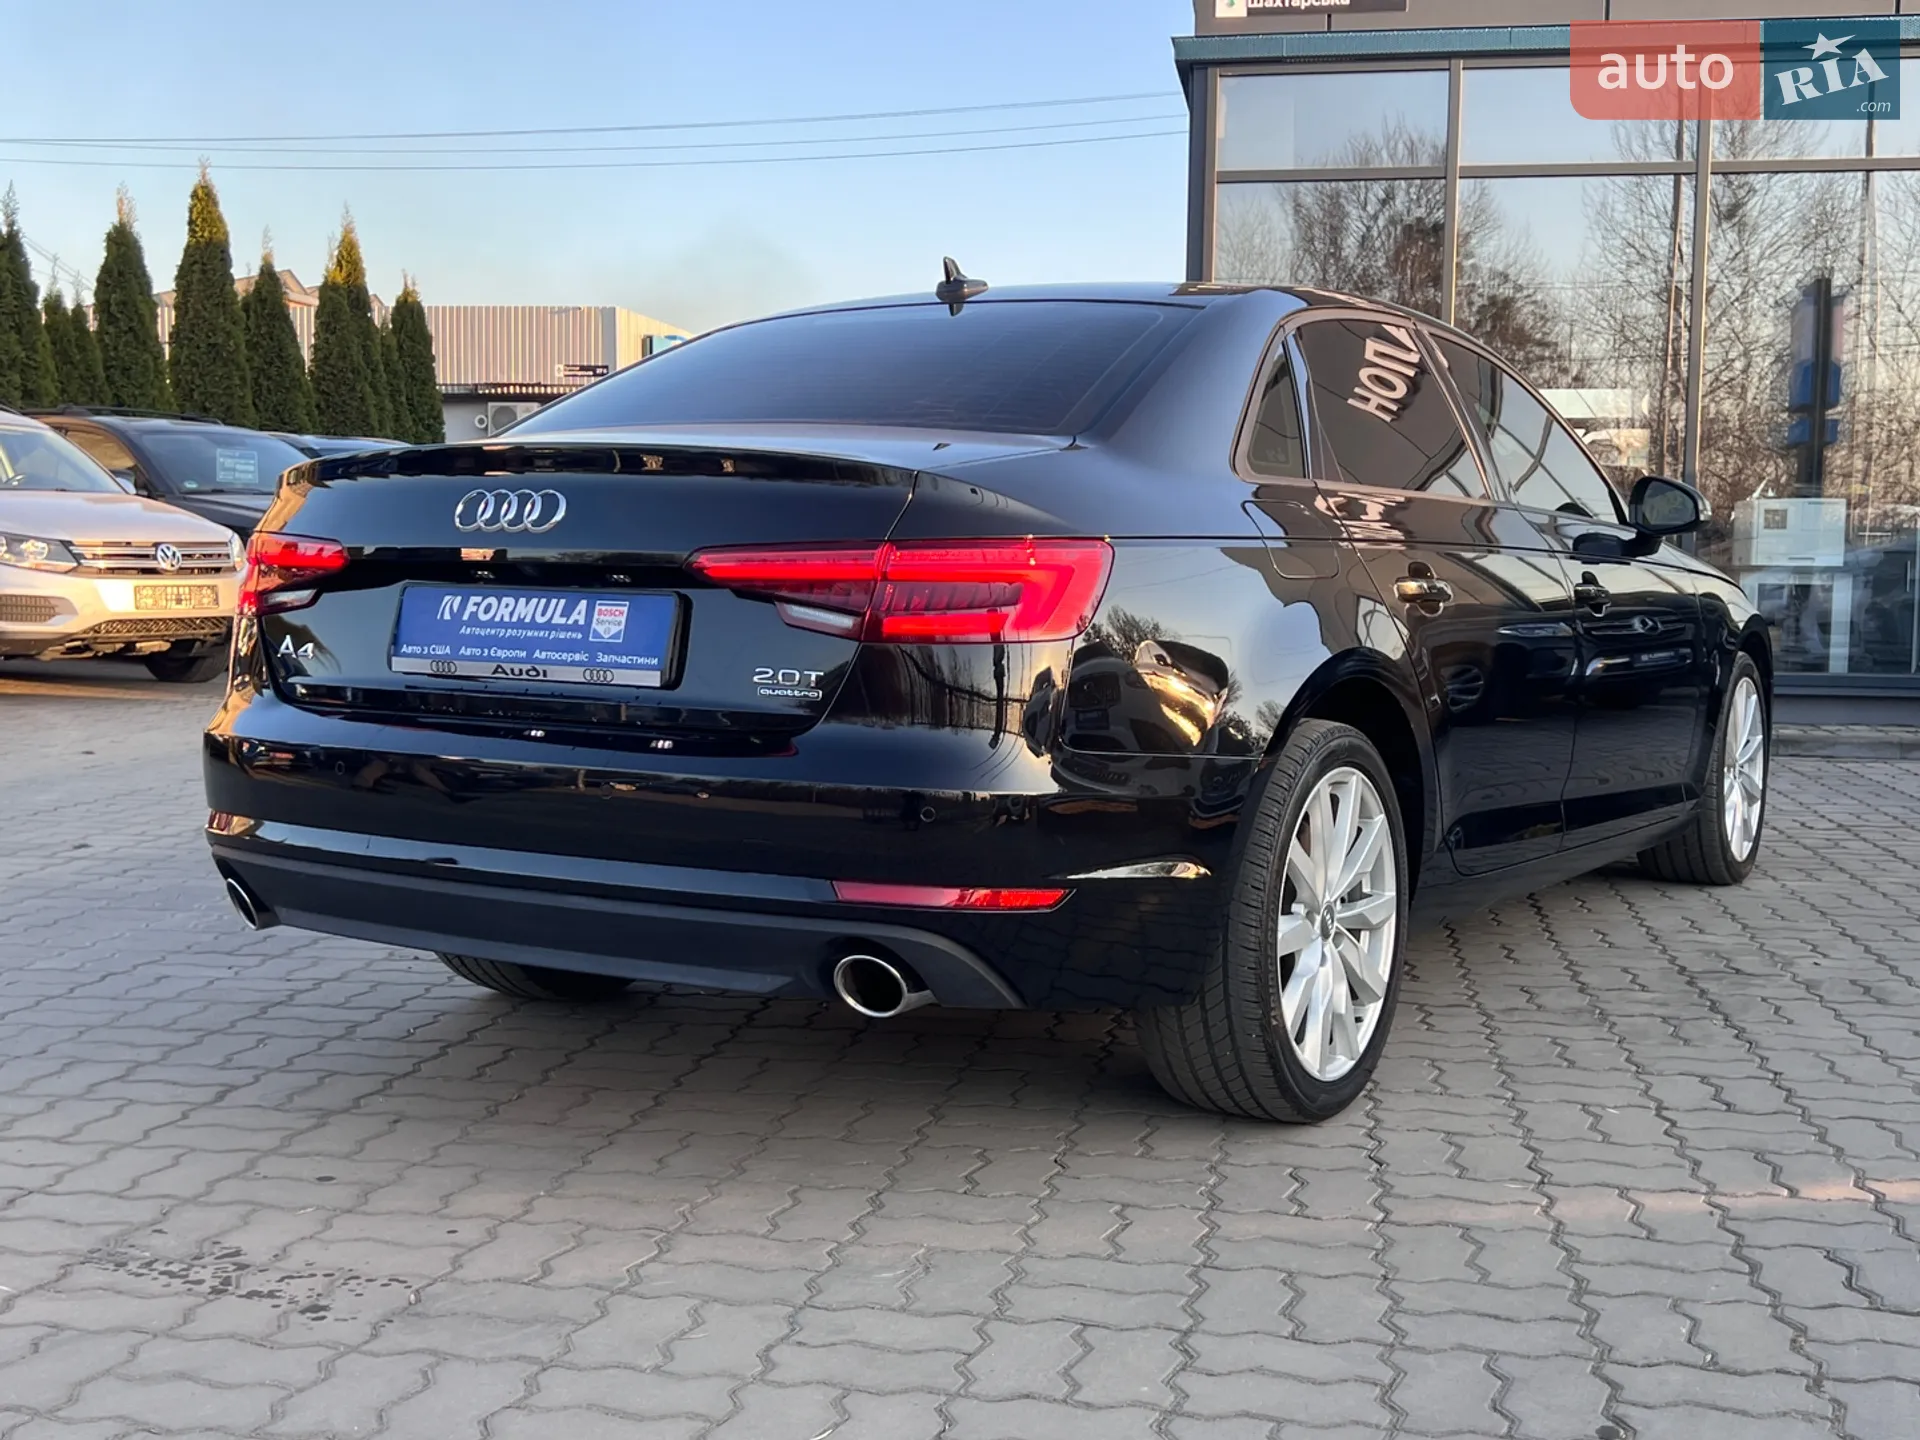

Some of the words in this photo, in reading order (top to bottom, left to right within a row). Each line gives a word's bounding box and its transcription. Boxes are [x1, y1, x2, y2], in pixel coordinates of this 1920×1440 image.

[462, 596, 587, 625] FORMULA
[597, 608, 625, 617] BOSCH
[595, 618, 623, 627] Service
[459, 625, 505, 637] Автоцентр
[505, 627, 549, 639] розумних
[549, 628, 583, 640] рішень
[277, 634, 315, 660] A4
[401, 644, 422, 654] Авто
[429, 645, 451, 655] США
[459, 646, 481, 656] Авто
[490, 647, 527, 659] Європи
[533, 649, 589, 663] Автосервіс
[595, 652, 659, 665] Запчастини
[491, 664, 548, 679] Audi
[760, 688, 818, 698] quattro
